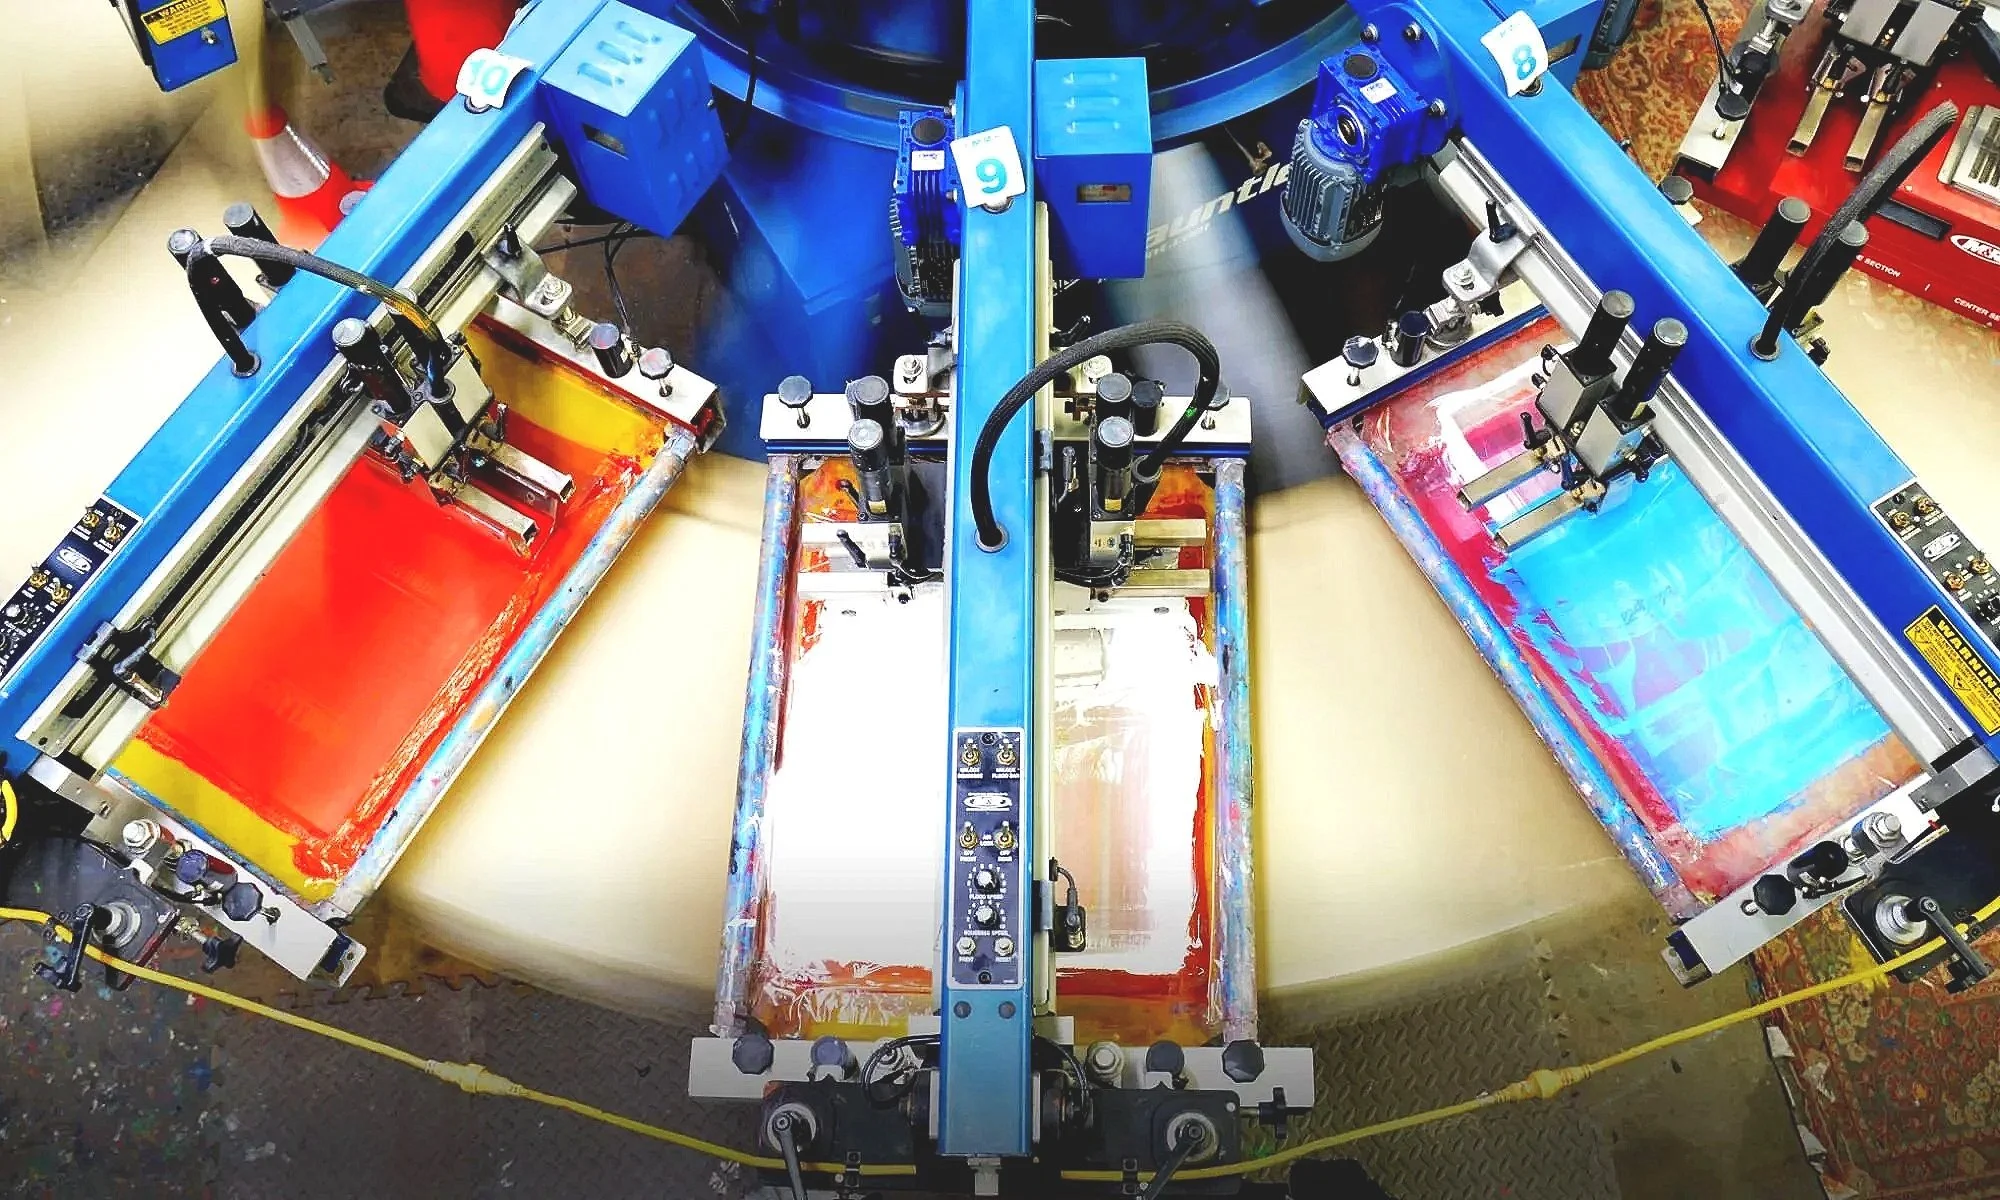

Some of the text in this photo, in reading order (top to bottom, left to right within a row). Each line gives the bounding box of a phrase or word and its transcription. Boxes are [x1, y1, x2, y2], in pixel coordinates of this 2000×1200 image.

[469, 59, 509, 96] 10
[1512, 44, 1537, 80] 8
[976, 158, 1008, 194] 9
[1863, 257, 1901, 278] SECTION
[1953, 296, 1990, 316] CENTER
